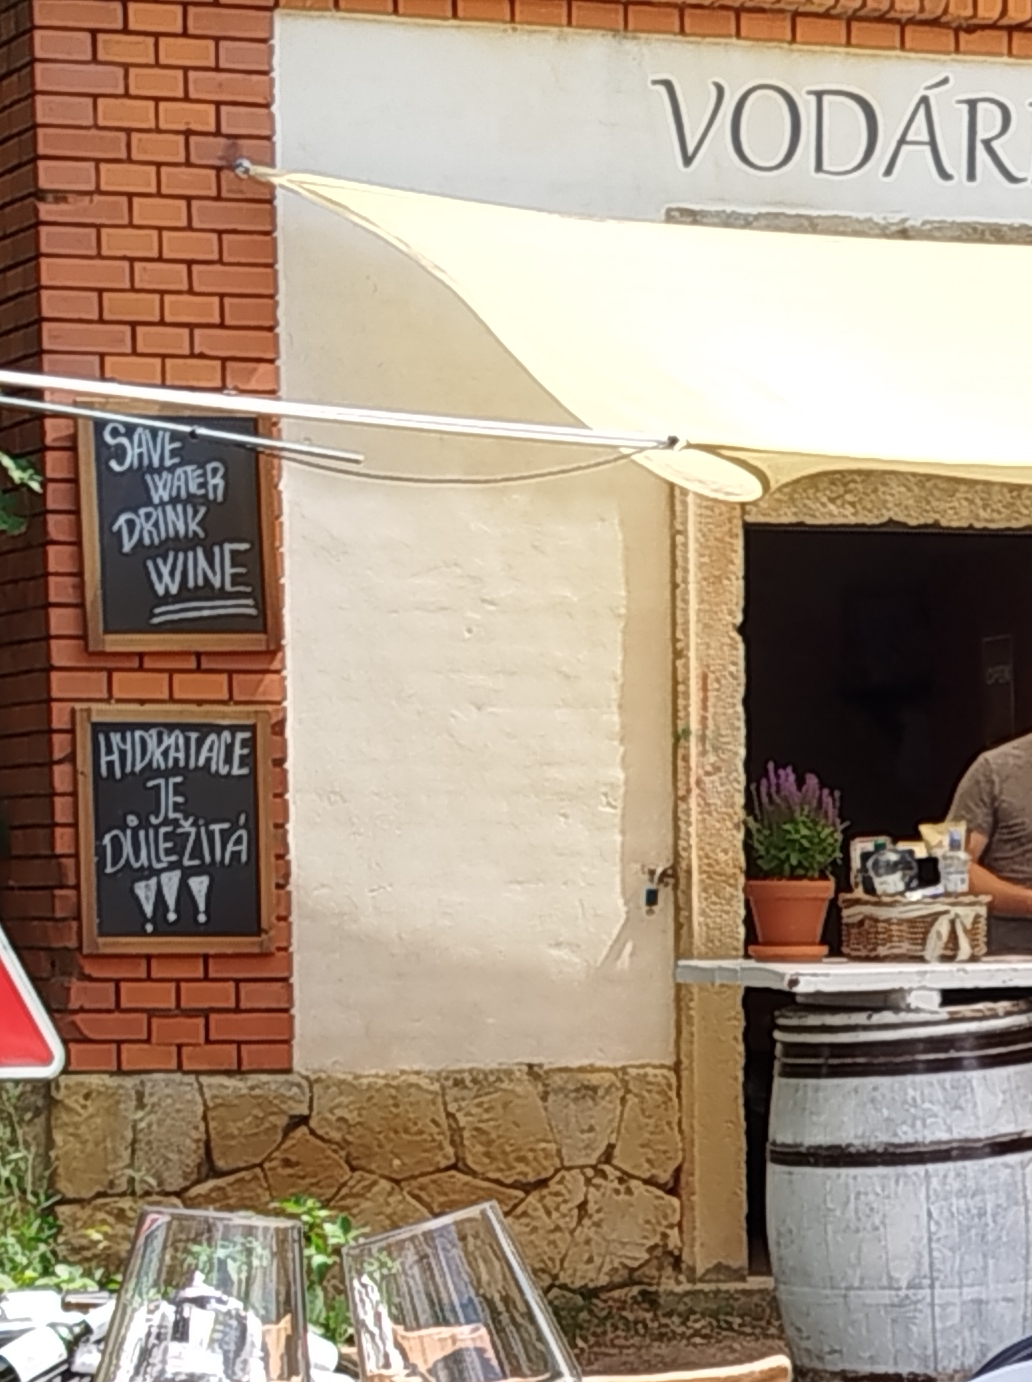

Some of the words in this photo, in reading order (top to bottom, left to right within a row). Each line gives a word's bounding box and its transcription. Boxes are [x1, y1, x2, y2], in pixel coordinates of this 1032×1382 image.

[103, 422, 183, 472] SAVE
[144, 460, 226, 504] WATER
[111, 503, 208, 554] DRINK
[146, 542, 253, 597] WINE
[98, 727, 253, 780] HYDRATACE
[146, 775, 186, 825] JE
